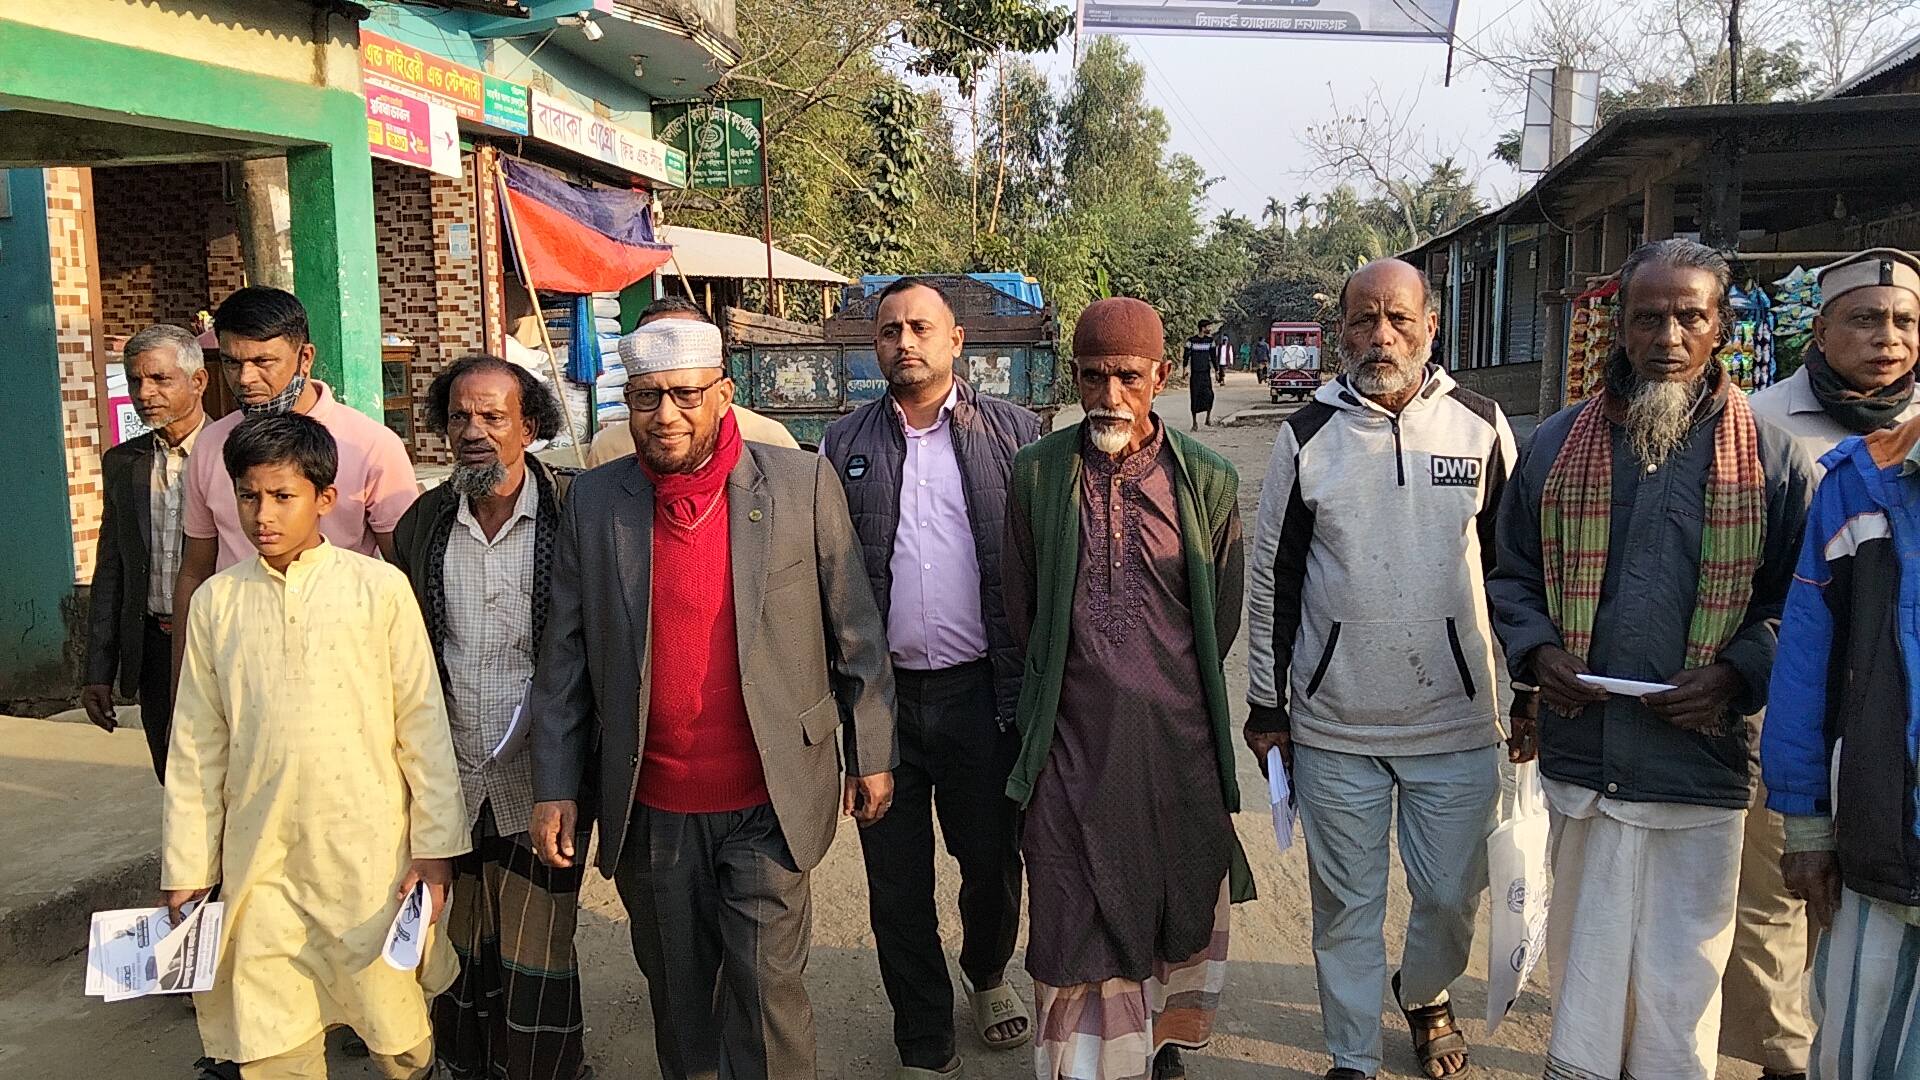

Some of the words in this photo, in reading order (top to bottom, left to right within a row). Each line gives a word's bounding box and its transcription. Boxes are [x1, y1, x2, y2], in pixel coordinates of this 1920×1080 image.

[537, 101, 582, 146] বারাকা
[588, 121, 617, 156] এগ্রো
[656, 113, 687, 144] াংলাদেশ
[1433, 458, 1480, 478] DWD
